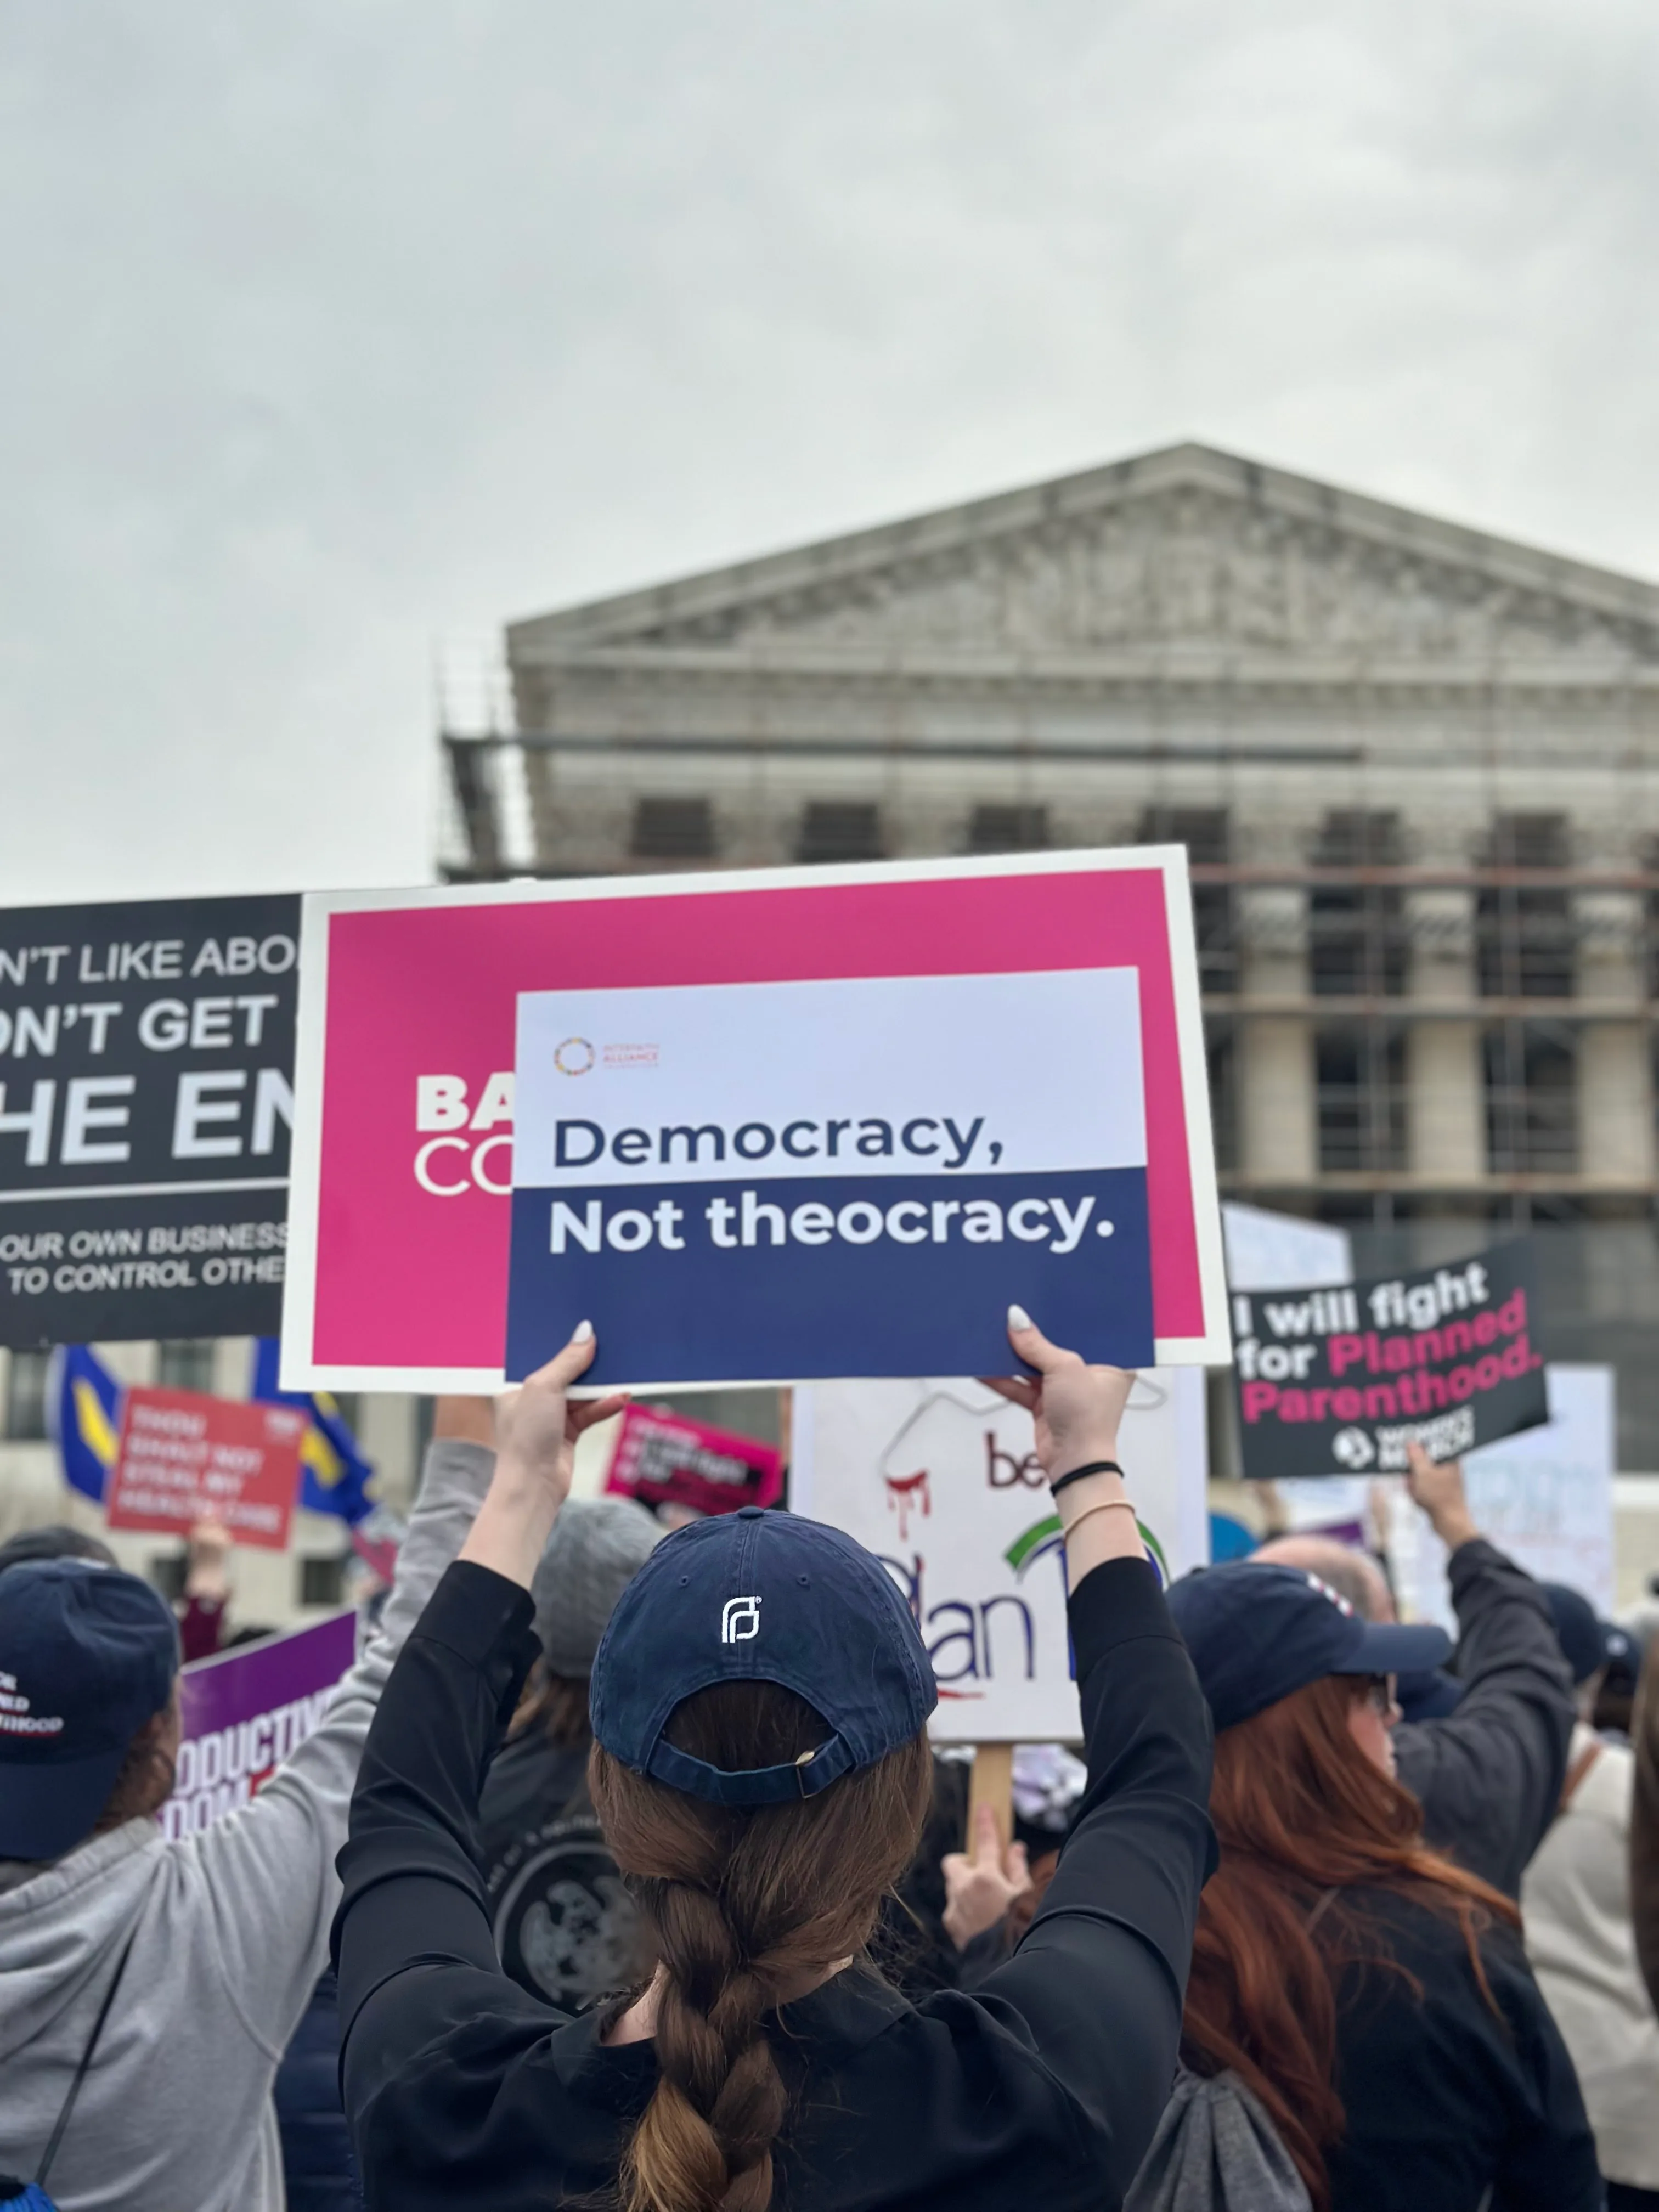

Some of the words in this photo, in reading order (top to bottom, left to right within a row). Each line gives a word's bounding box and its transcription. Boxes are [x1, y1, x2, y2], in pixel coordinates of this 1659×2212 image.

[0, 944, 71, 986] N'T
[78, 940, 184, 983] LIKE
[190, 934, 300, 978] ABO
[0, 1002, 122, 1059] N'T
[138, 994, 278, 1052] GET
[0, 1075, 136, 1167] HE
[416, 1071, 515, 1132] BA
[554, 1117, 1003, 1169] Democracy,
[0, 1232, 64, 1262] OUR
[69, 1227, 143, 1259] OWN
[147, 1221, 289, 1255] BUSINESS
[550, 1200, 686, 1254] Not
[706, 1191, 1115, 1254] theocracy.
[7, 1266, 49, 1295] TO
[53, 1260, 198, 1293] CONTROL
[201, 1255, 286, 1285] OTHE
[1233, 1295, 1252, 1336] I
[1264, 1289, 1358, 1336] will
[1368, 1262, 1489, 1330] fight
[1235, 1338, 1316, 1380] for
[1327, 1287, 1528, 1377] Planned
[1241, 1334, 1543, 1424] Parenthood.
[985, 1431, 1047, 1491] be
[1379, 1427, 1475, 1471] MRCH
[173, 1684, 336, 1796] ODUCTIV
